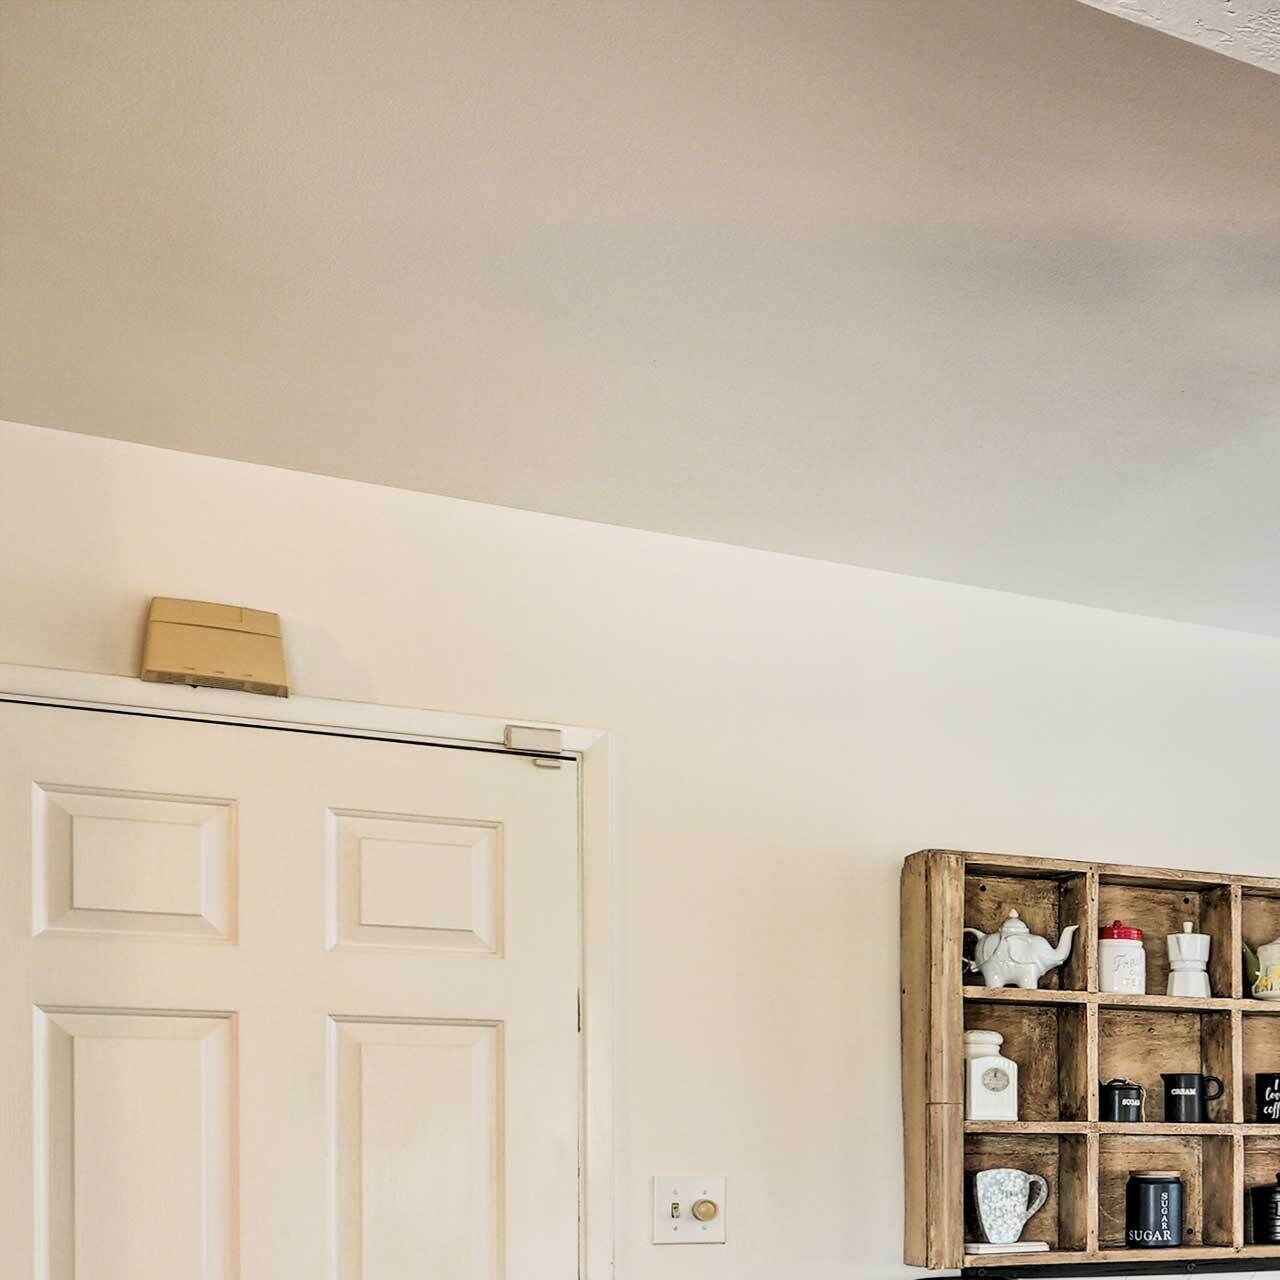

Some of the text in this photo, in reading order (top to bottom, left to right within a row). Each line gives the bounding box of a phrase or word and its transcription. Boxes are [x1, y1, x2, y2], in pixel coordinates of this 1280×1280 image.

[1274, 1078, 1280, 1091] I
[1170, 1088, 1197, 1096] CREAM
[1128, 1230, 1173, 1241] SUGAR
